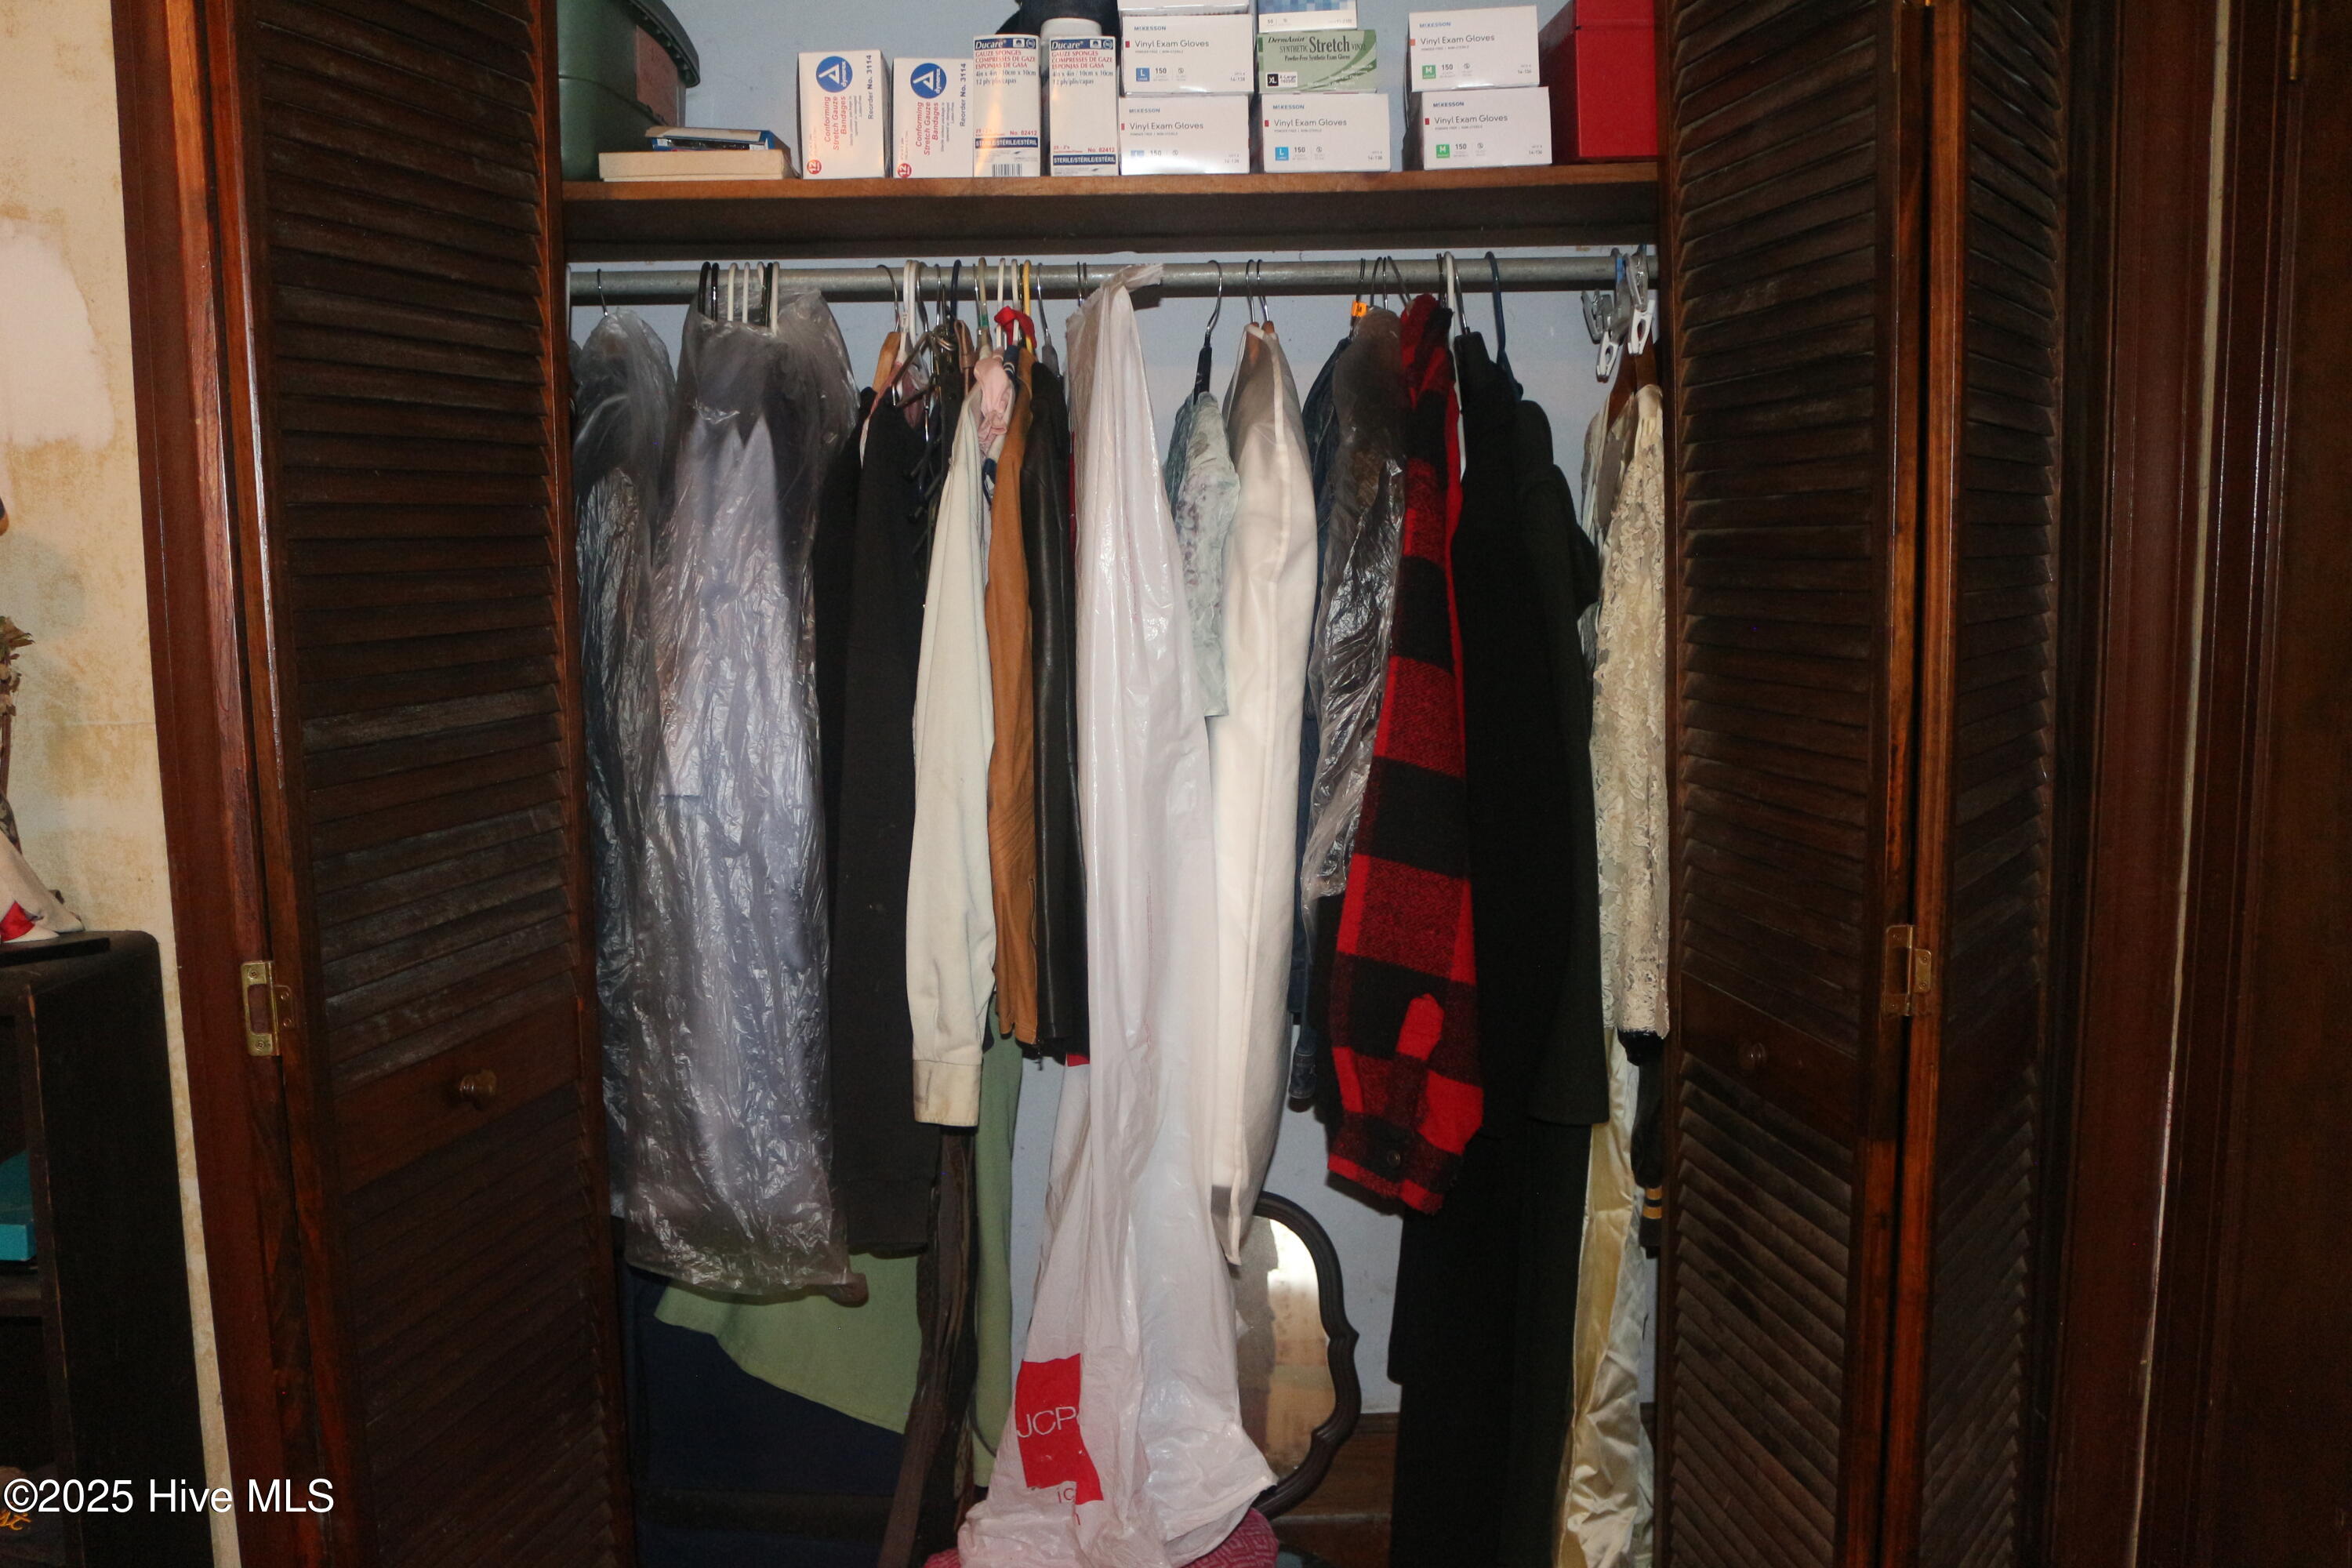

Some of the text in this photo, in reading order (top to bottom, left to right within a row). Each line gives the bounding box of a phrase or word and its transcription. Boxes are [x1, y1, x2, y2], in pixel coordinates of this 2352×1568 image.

[1134, 40, 1154, 49] Vinyl
[1180, 39, 1210, 48] Gloves
[1308, 35, 1350, 53] Stretch
[1421, 37, 1440, 45] Vinyl
[1140, 68, 1146, 77] L
[1274, 119, 1293, 128] Vinyl
[1434, 117, 1454, 125] Vinyl
[1130, 122, 1149, 132] Vinyl
[808, 161, 816, 174] 12
[898, 165, 906, 176] 12
